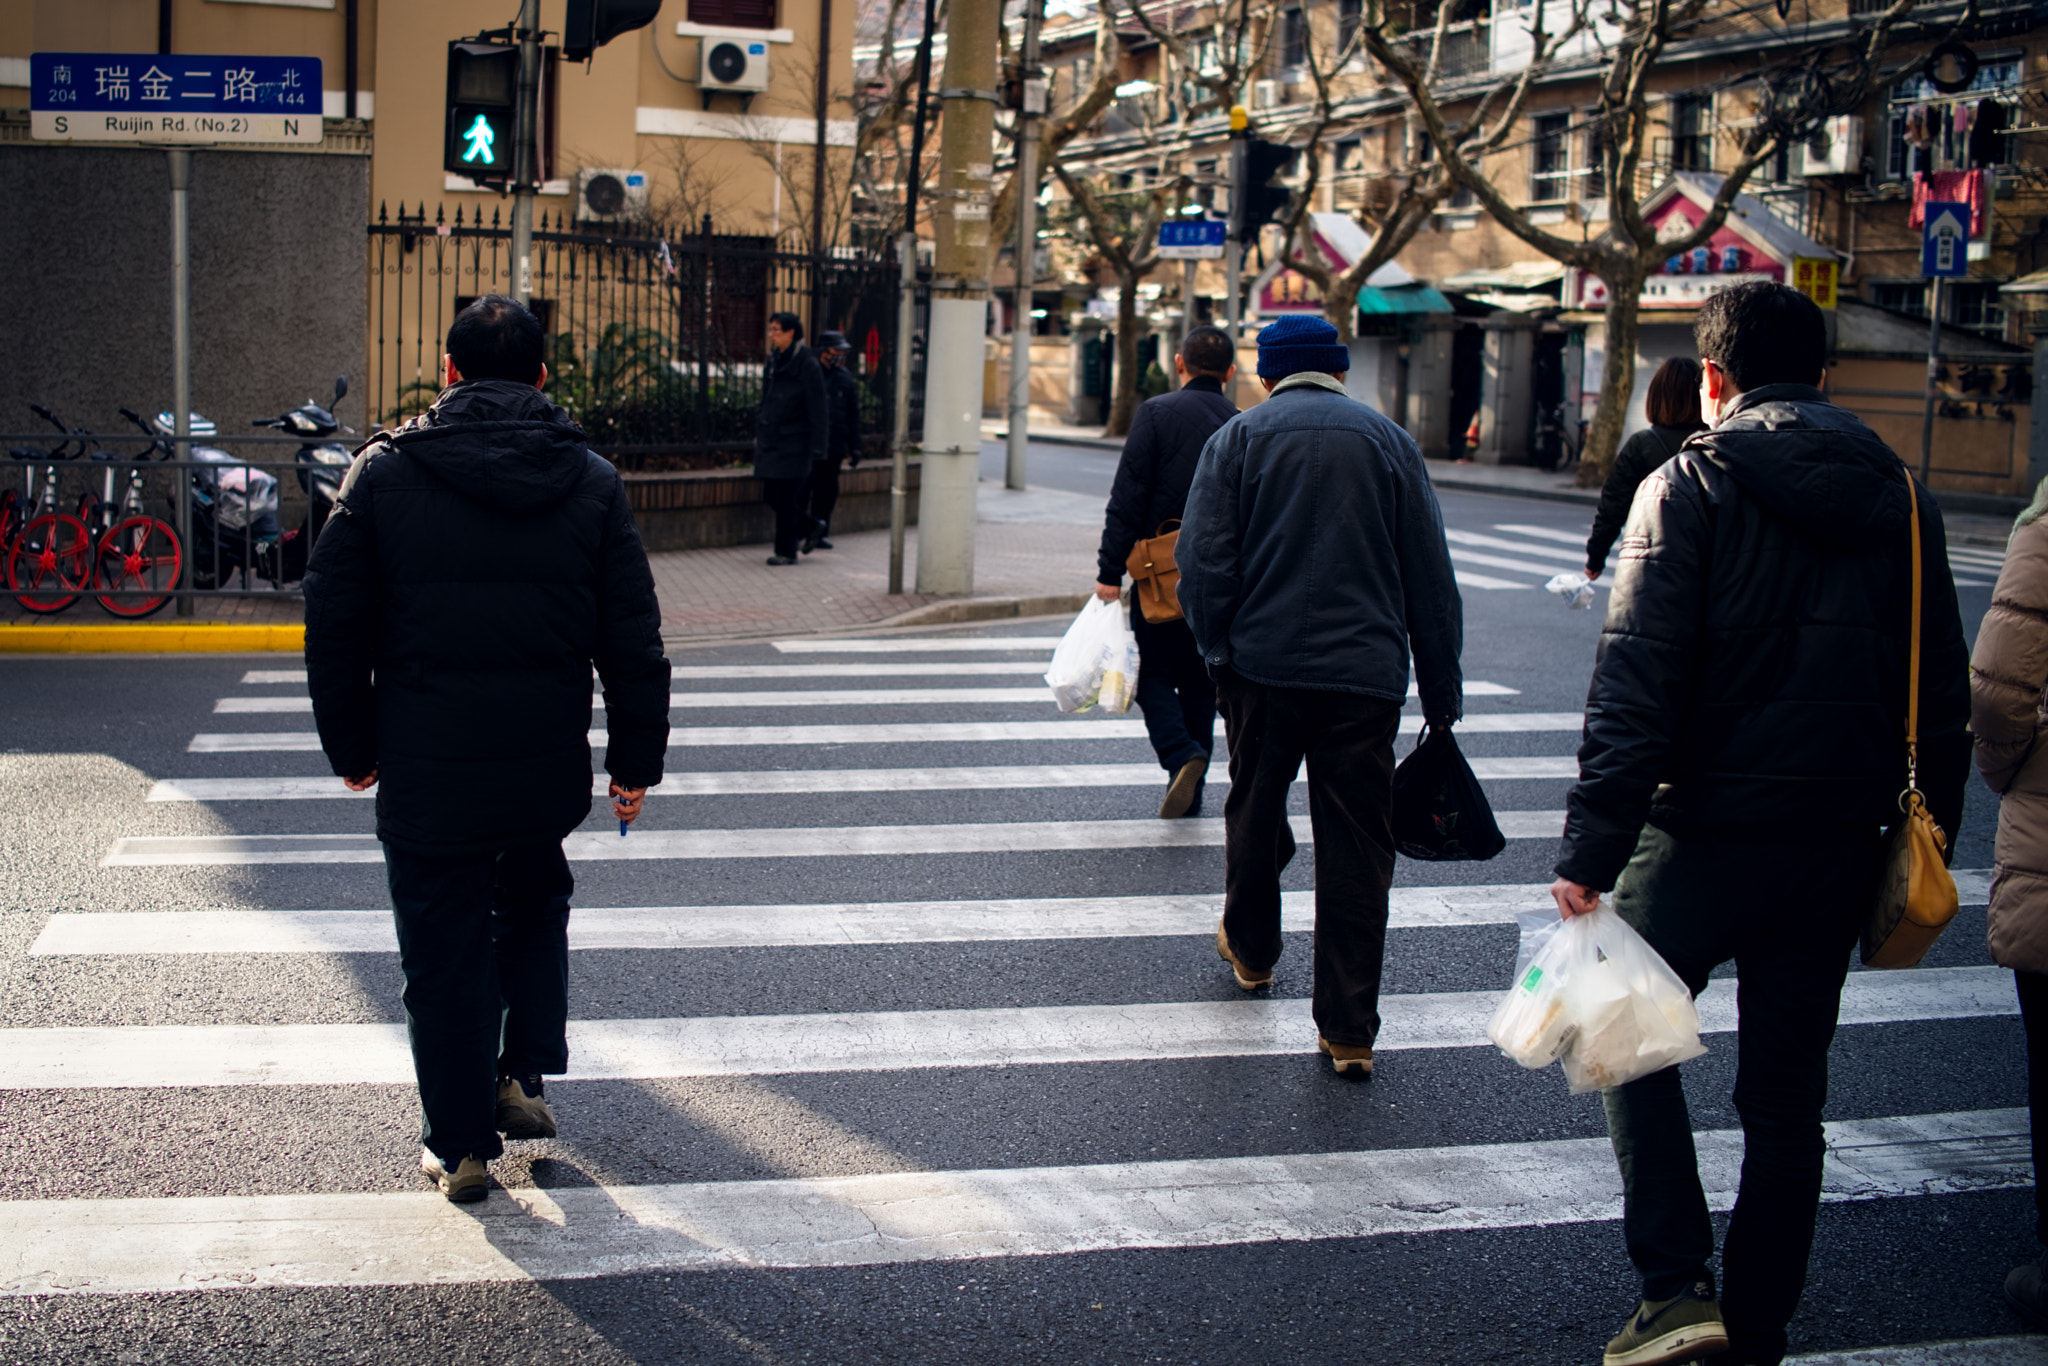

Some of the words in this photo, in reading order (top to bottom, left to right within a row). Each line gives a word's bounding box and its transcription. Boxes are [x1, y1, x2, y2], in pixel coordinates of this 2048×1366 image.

[53, 65, 71, 85] 南
[94, 65, 257, 102] 瑞金二路
[281, 67, 301, 87] 北
[49, 89, 76, 102] 204
[278, 92, 304, 105] 144
[54, 116, 68, 133] S
[105, 117, 153, 135] Ruijin
[284, 119, 298, 136] N
